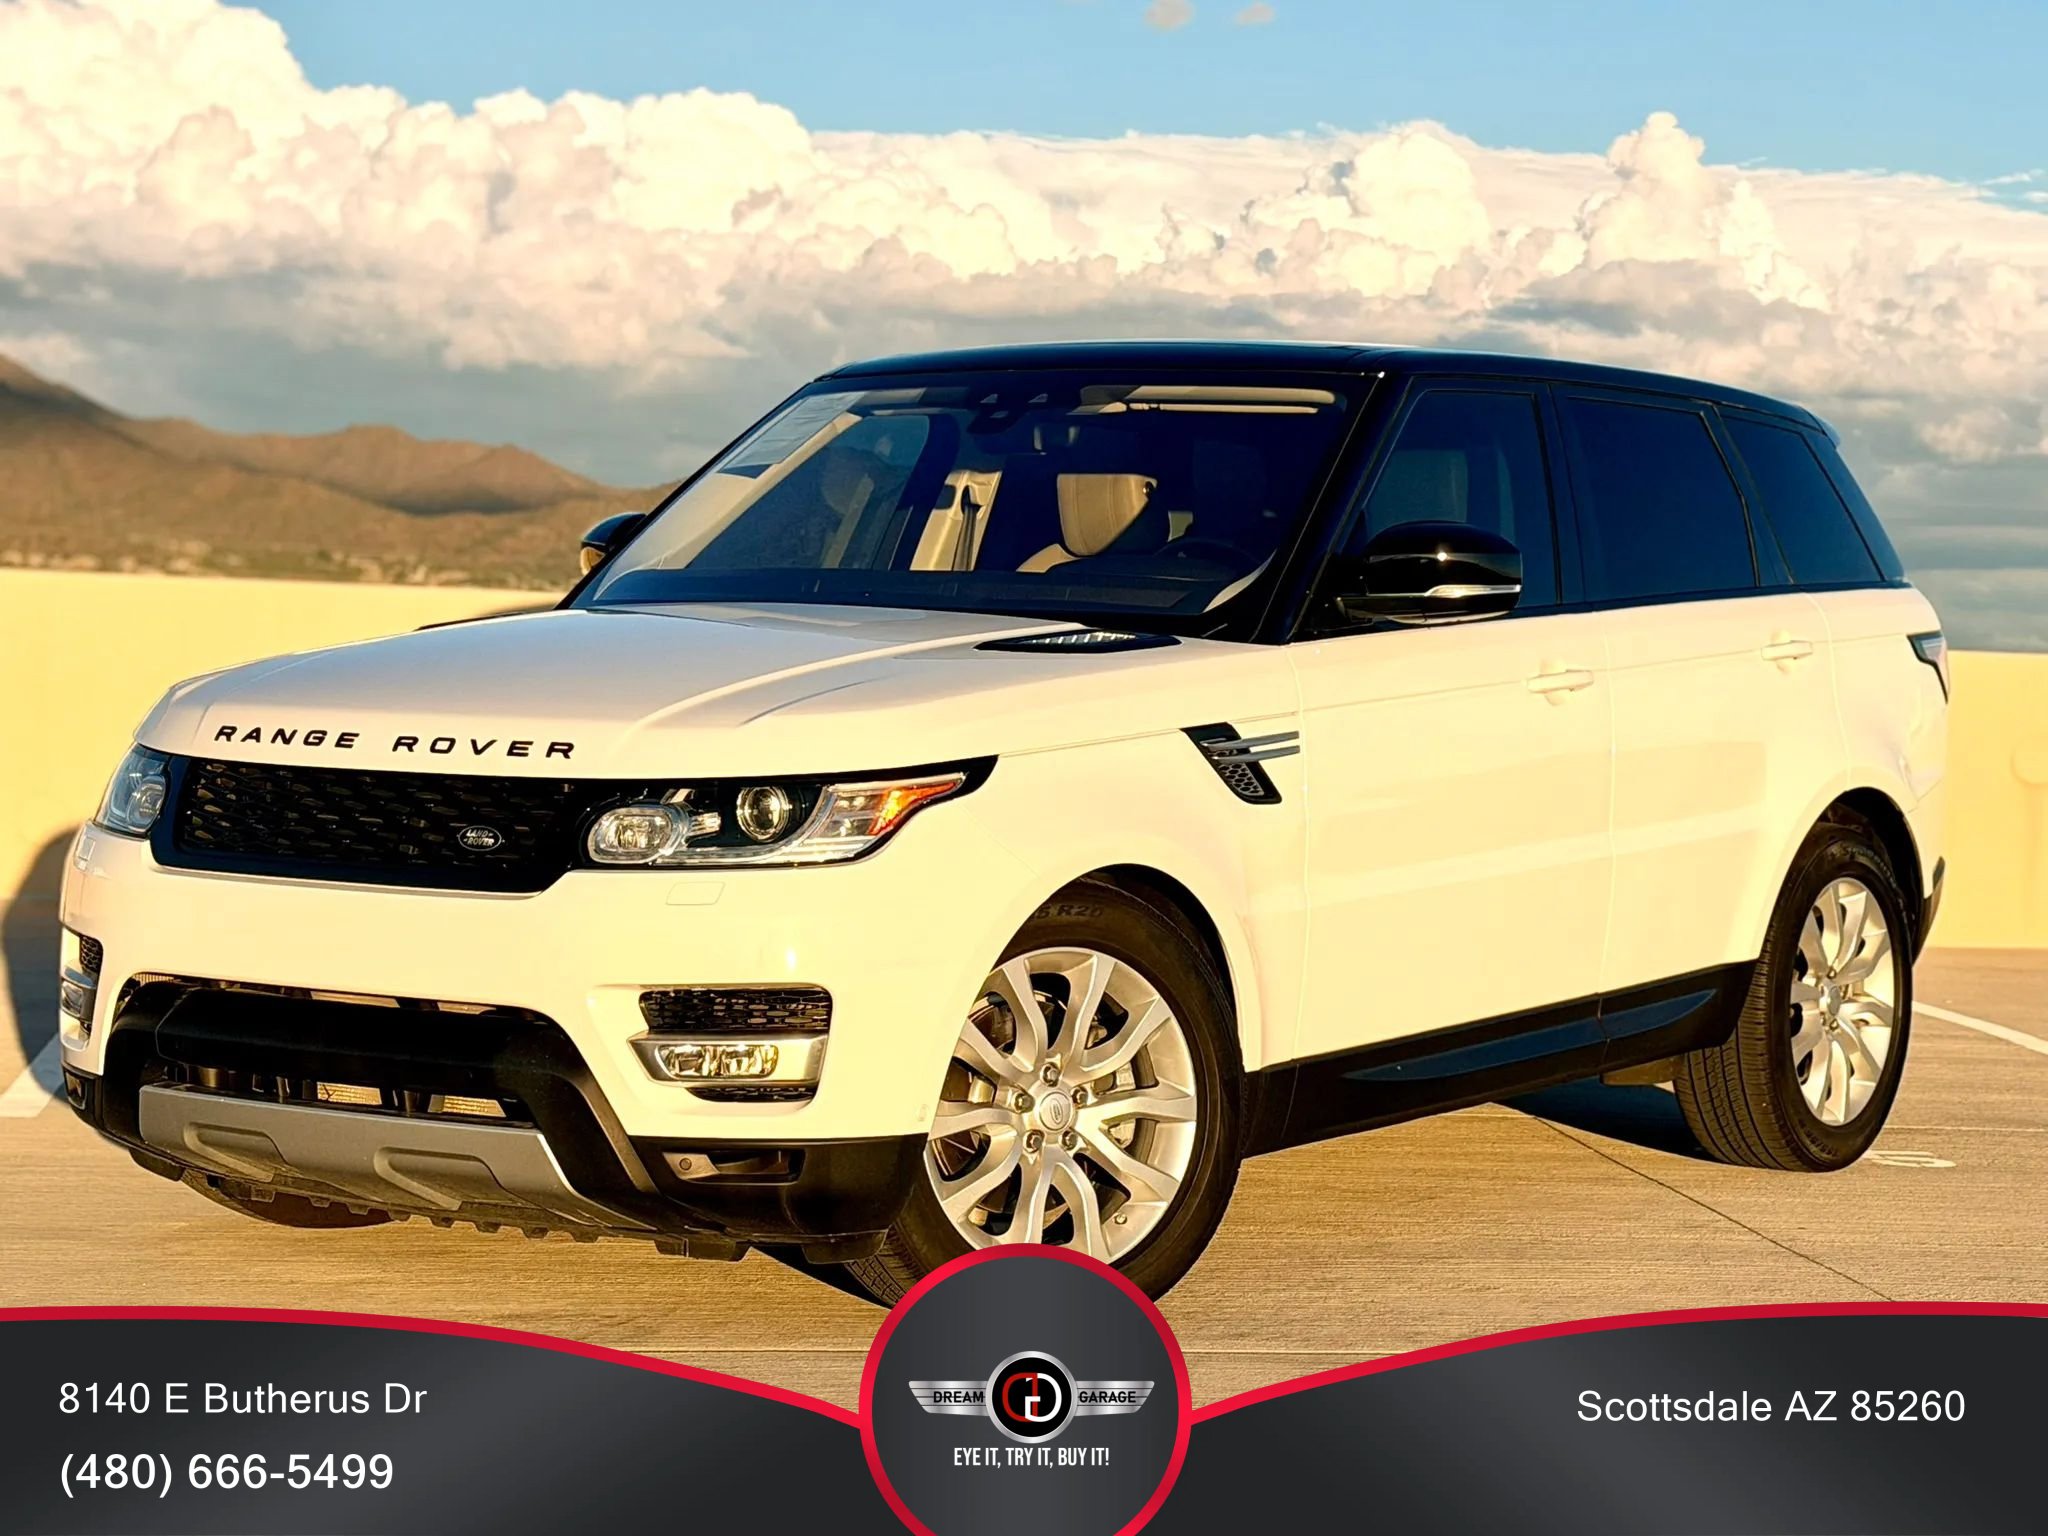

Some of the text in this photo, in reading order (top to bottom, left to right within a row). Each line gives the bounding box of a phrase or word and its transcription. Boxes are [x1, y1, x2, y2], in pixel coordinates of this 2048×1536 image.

[214, 725, 575, 759] RANGE ROVER
[466, 829, 489, 837] LAND
[468, 837, 495, 846] ROVER
